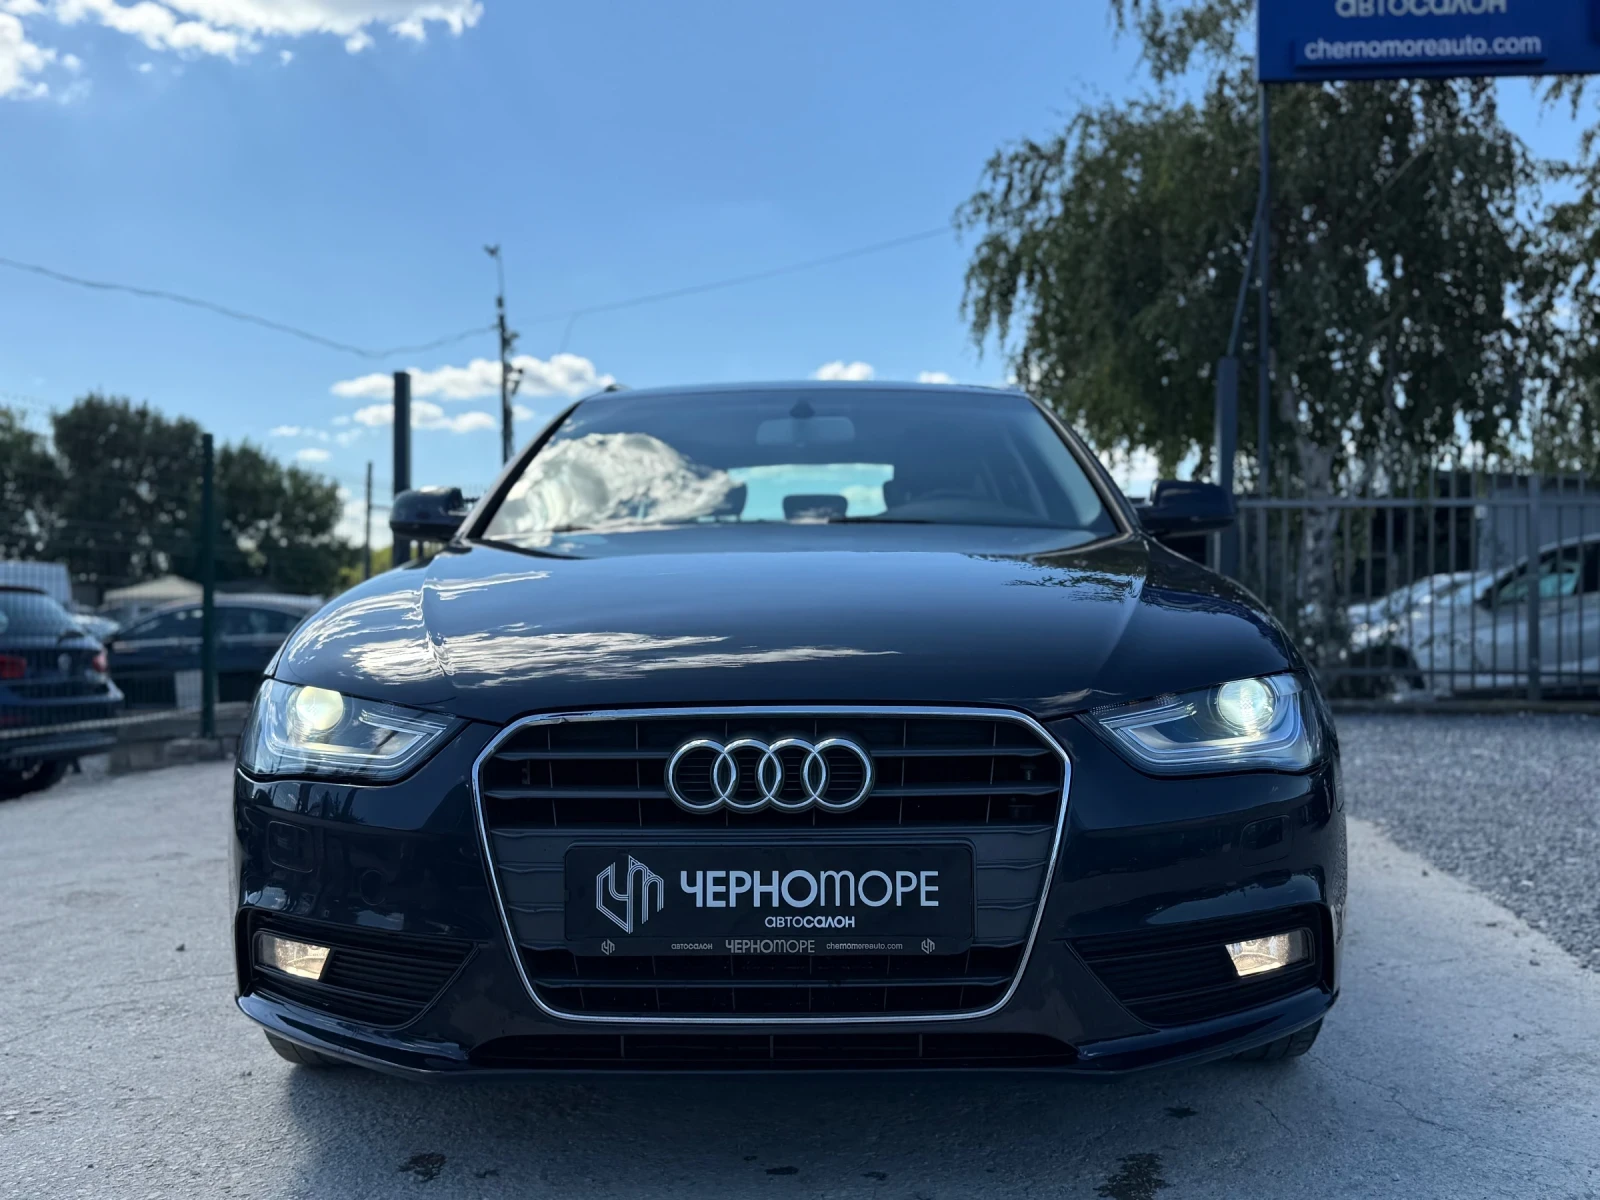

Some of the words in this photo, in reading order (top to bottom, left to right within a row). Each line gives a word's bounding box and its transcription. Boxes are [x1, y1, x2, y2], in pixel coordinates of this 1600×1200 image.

[1304, 35, 1542, 60] chernomoreauto.com
[680, 869, 939, 908] ЧЕРНОМОРЕ
[764, 915, 856, 929] автосалон
[670, 942, 713, 950] автосалон
[725, 939, 816, 954] ЧЕРНОМОРЕ
[825, 941, 904, 950] chernomoreauto.com
